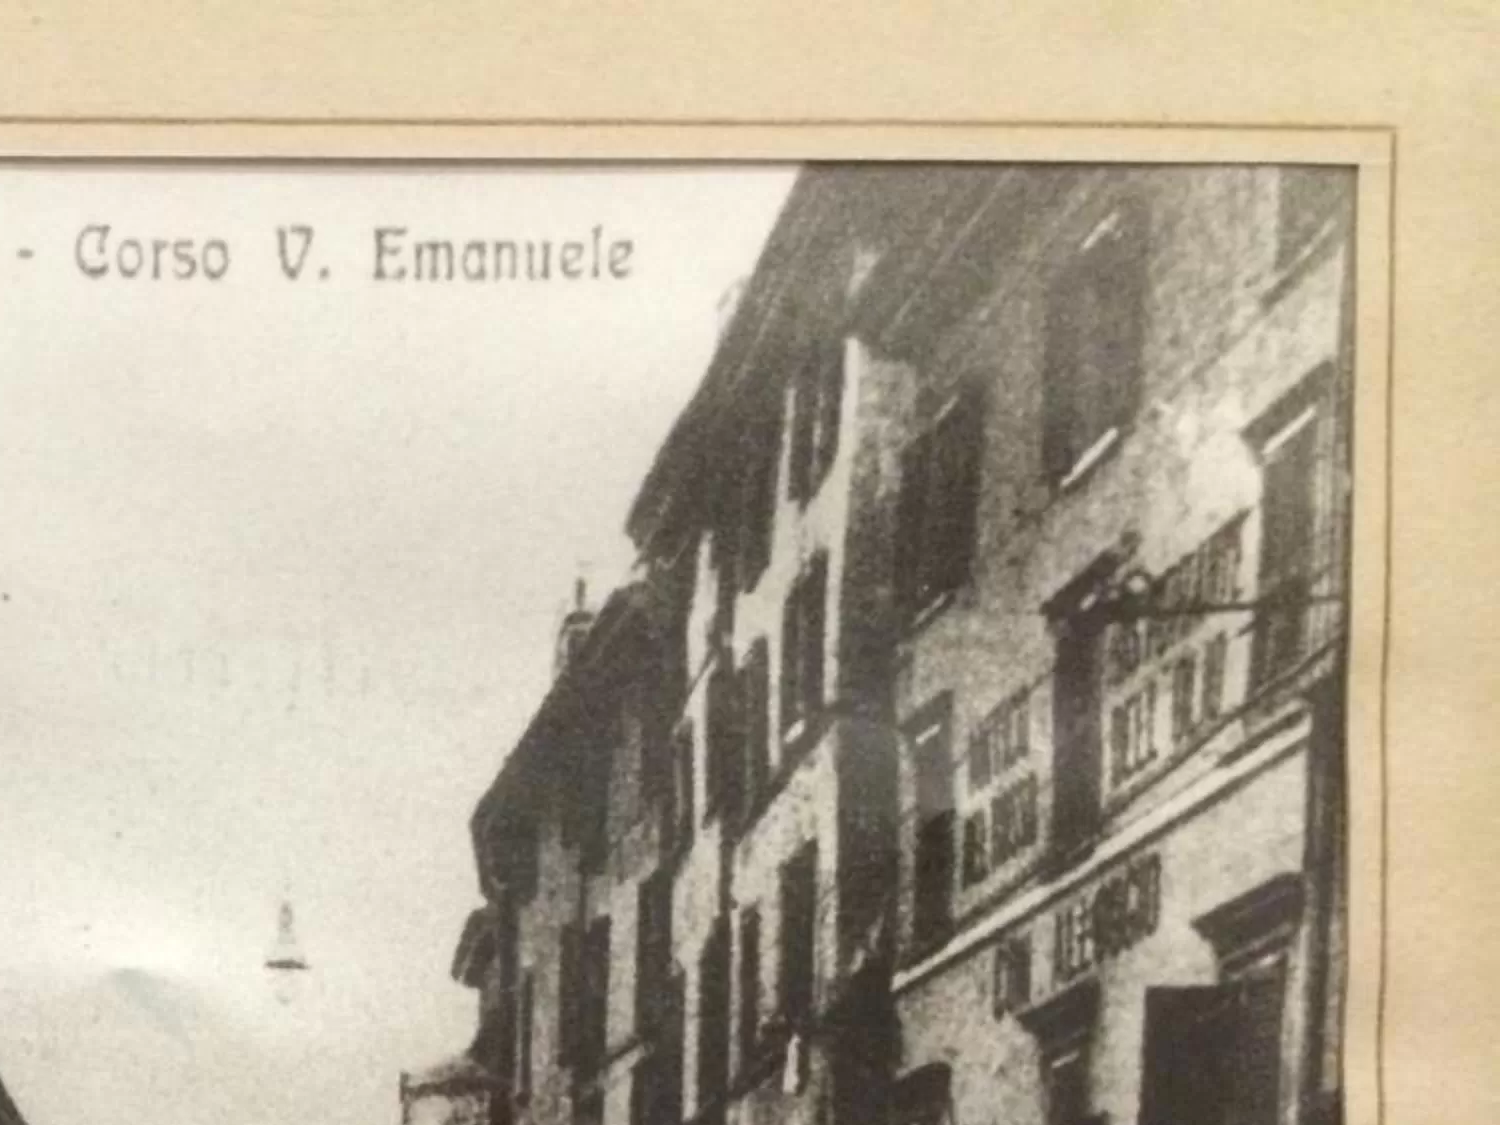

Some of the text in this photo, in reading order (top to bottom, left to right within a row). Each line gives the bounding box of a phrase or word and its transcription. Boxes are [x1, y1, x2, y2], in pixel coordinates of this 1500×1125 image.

[75, 224, 230, 281] Corso
[276, 225, 330, 281] V.
[372, 225, 634, 281] Emanuele
